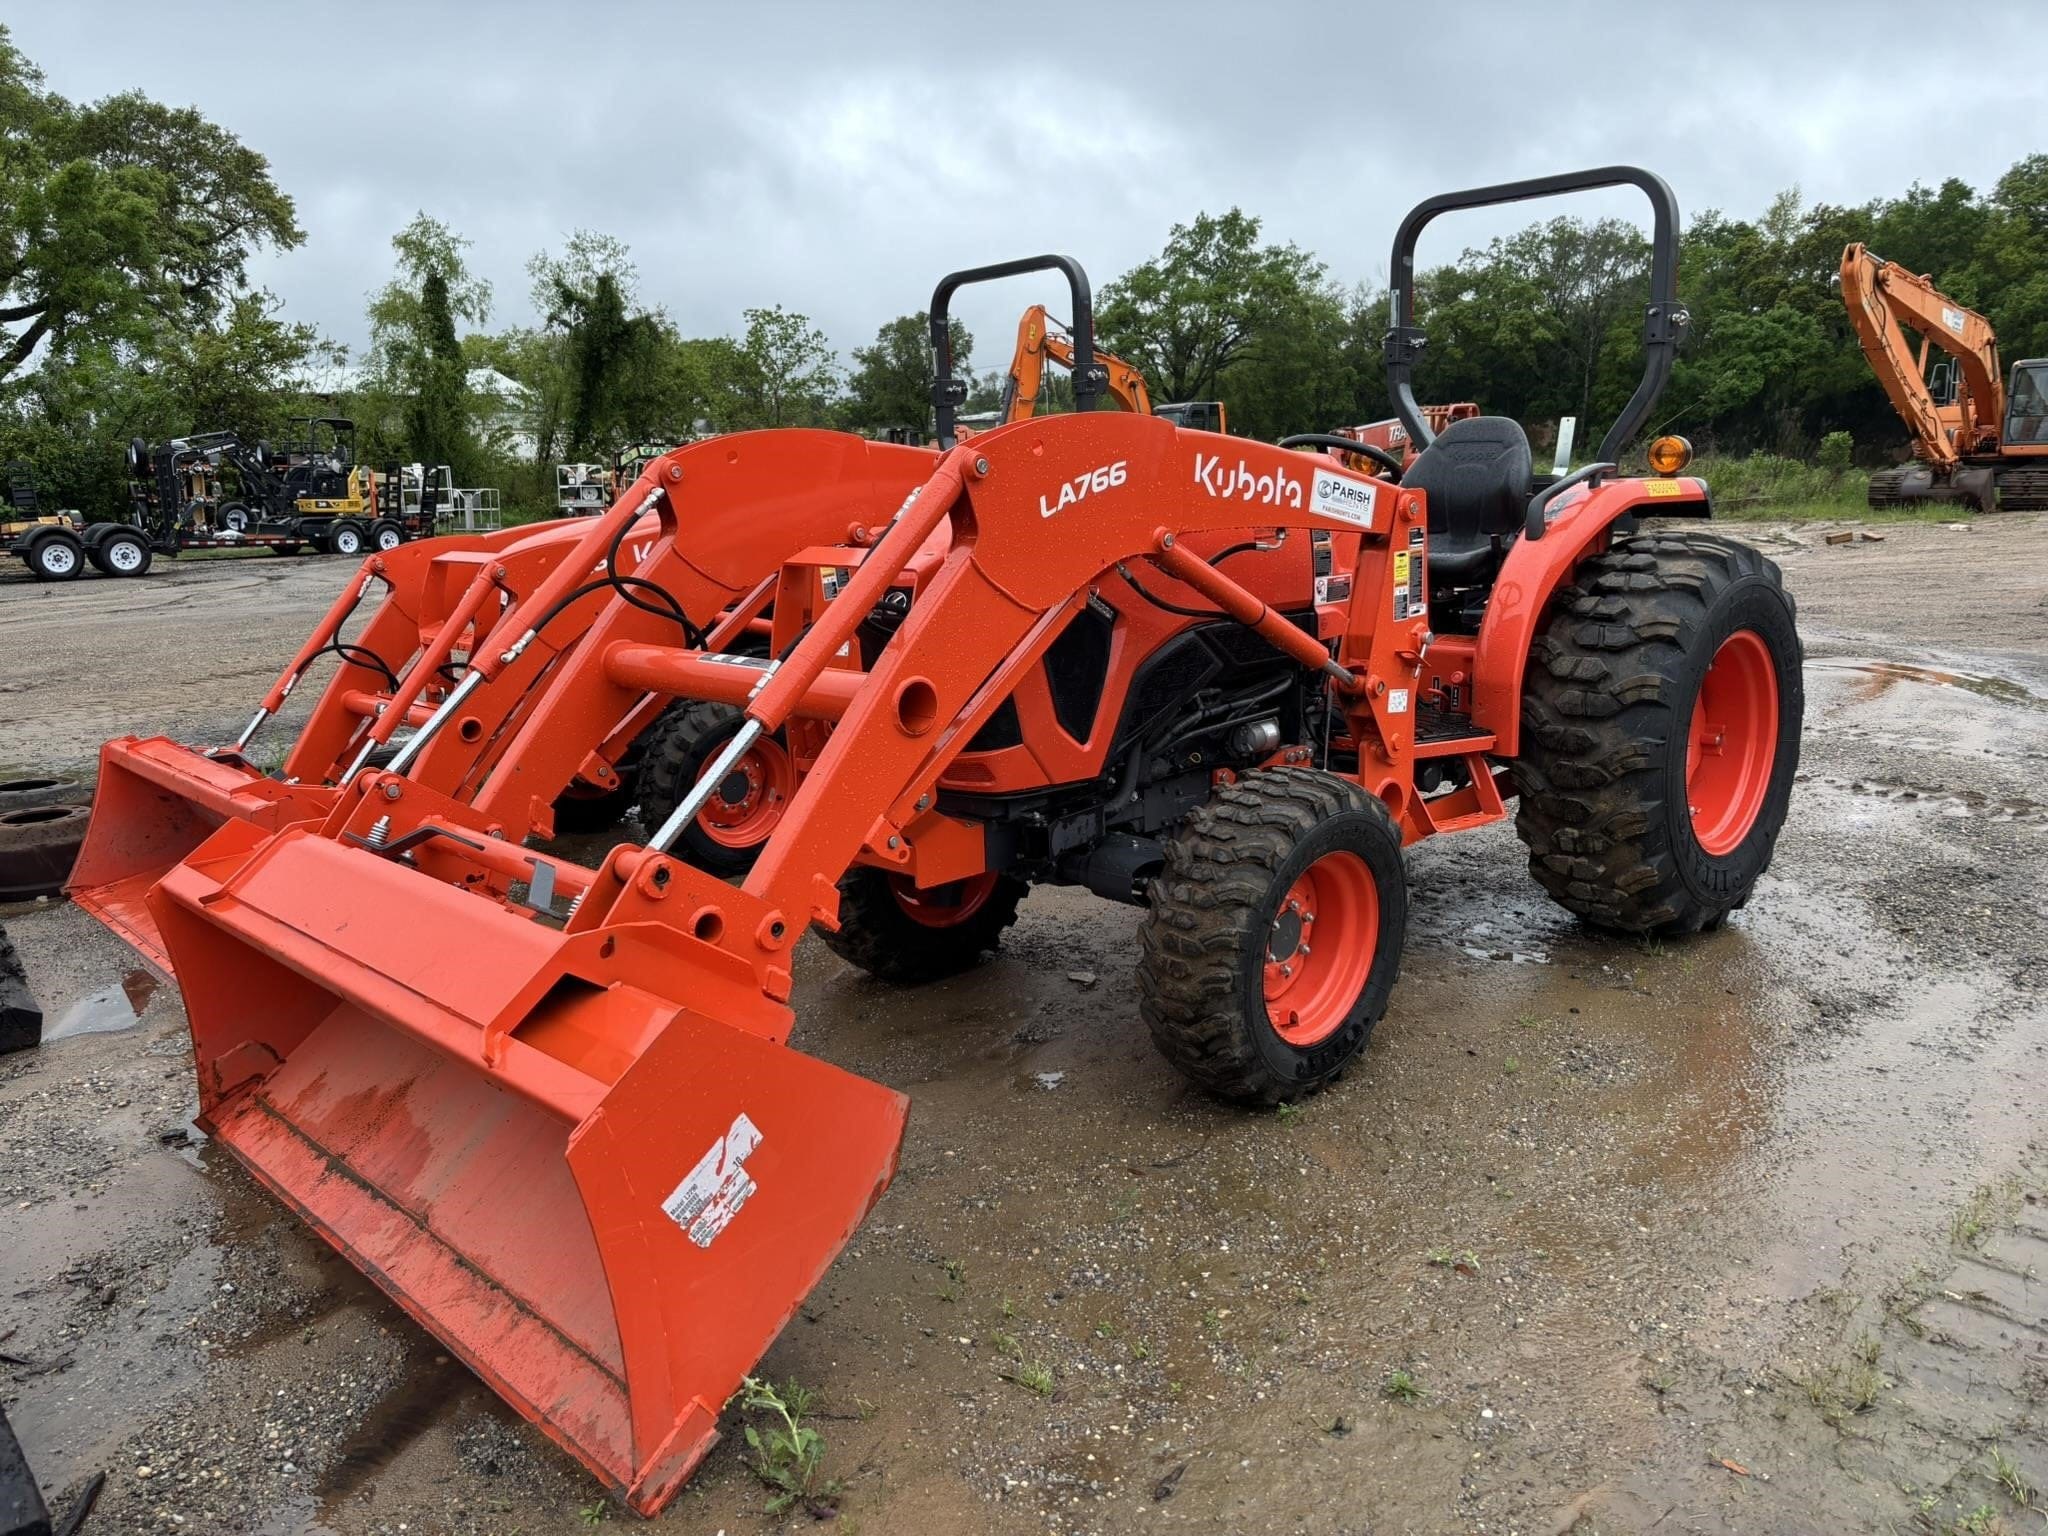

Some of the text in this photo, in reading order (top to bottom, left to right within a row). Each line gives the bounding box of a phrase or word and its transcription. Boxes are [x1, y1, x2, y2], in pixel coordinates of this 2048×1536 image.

[1039, 461, 1127, 519] LA766
[1194, 453, 1302, 508] Kubota
[1332, 481, 1371, 504] PARISH
